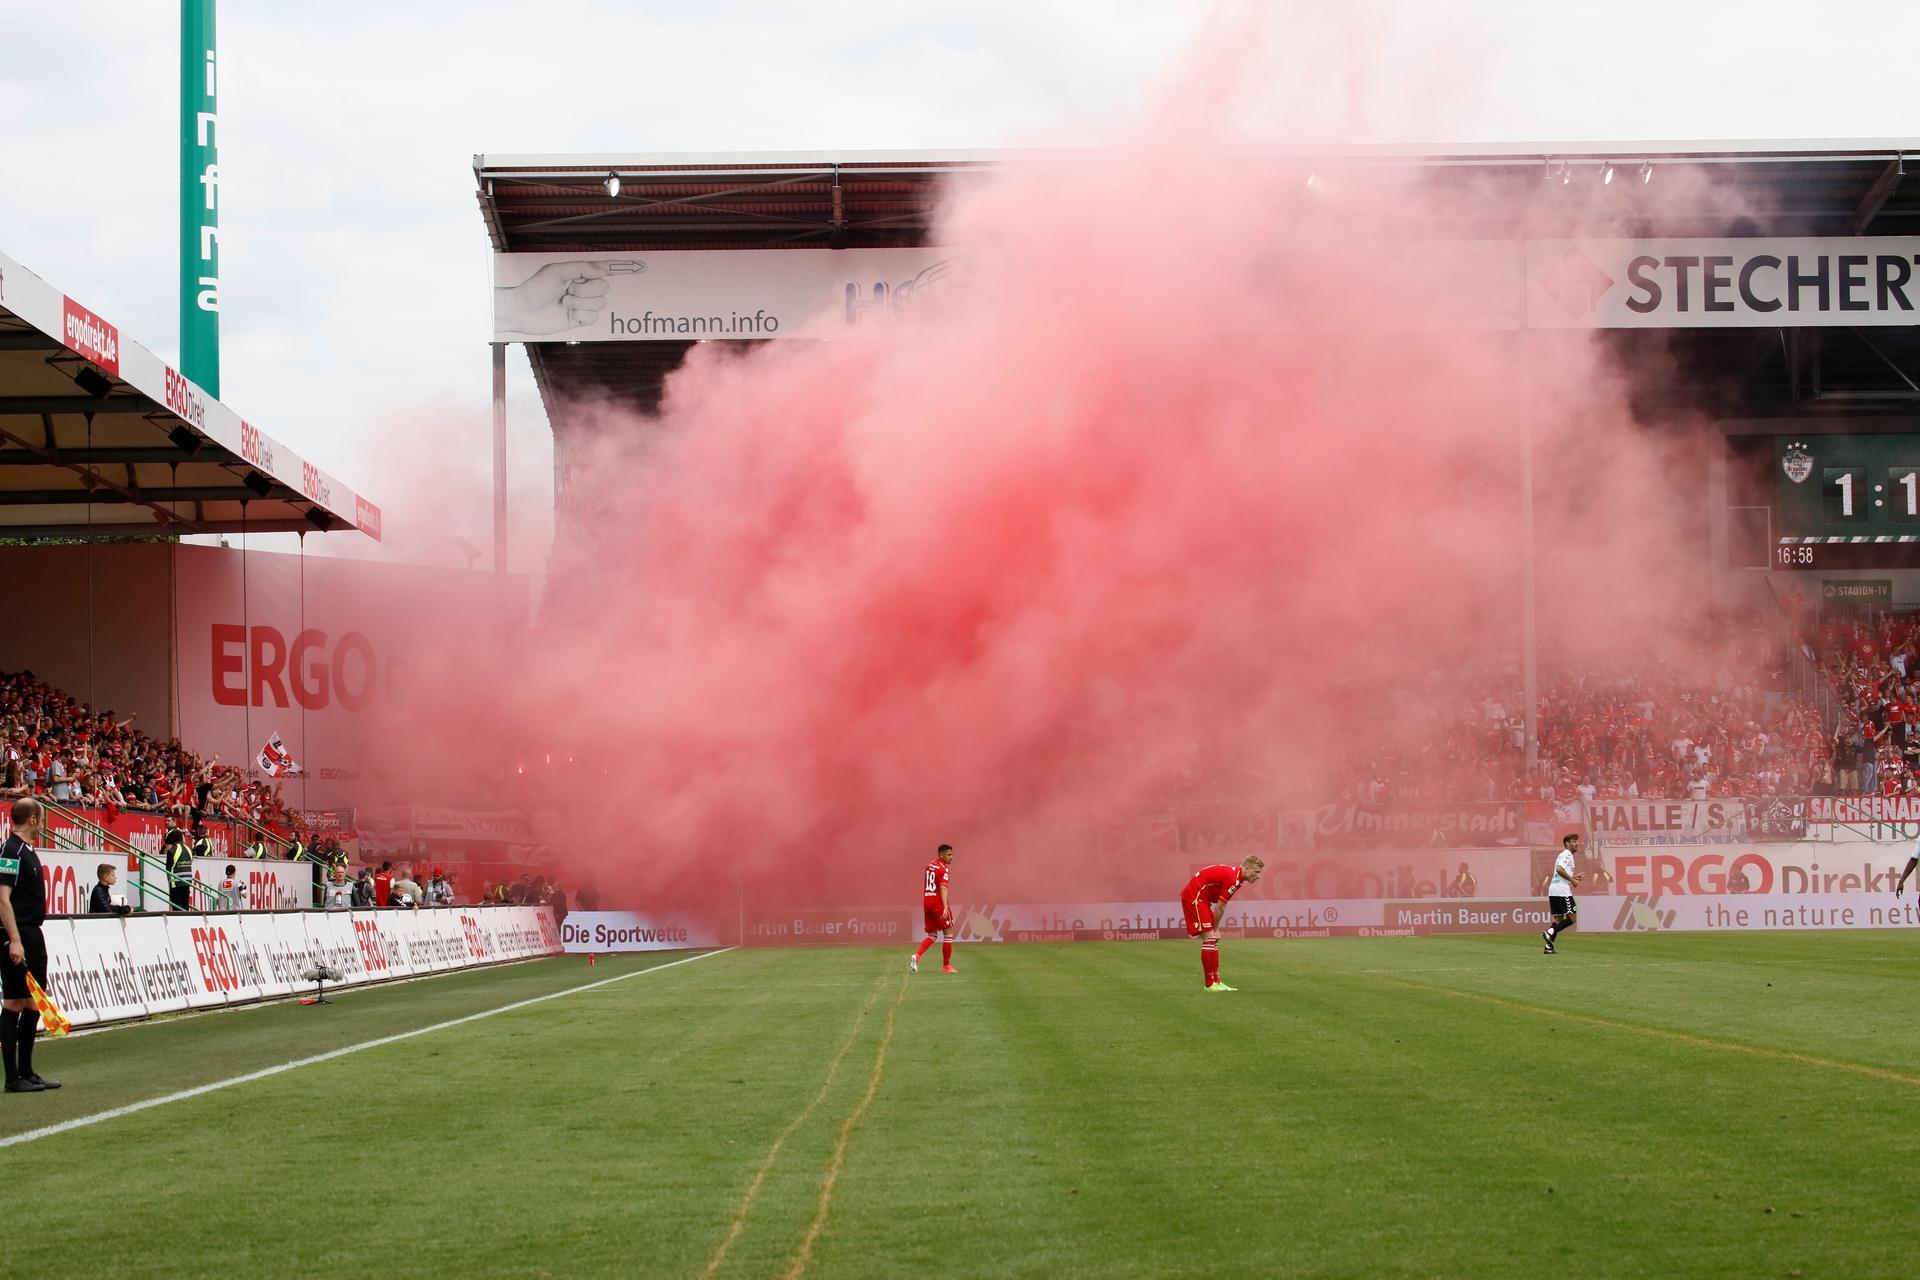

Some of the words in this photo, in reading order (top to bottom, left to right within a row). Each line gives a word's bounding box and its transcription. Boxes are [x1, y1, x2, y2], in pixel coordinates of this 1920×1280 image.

[611, 310, 779, 334] hofmann.info
[67, 312, 116, 363] ergodirekt.de
[165, 366, 188, 418] ERGO
[188, 391, 206, 429] Direkt
[241, 421, 260, 465] ERGO
[303, 461, 318, 500] ERGO
[1835, 473, 1852, 516] 1
[1899, 472, 1917, 516] 1
[1777, 547, 1813, 564] 16:58
[1838, 586, 1887, 596] STADION-TV
[211, 623, 376, 712] ERGO
[1590, 805, 1682, 831] HALLE
[926, 870, 937, 891] 18
[1614, 853, 1774, 895] ERGO
[1782, 863, 1901, 894] Direkt
[250, 871, 277, 909] ERGO
[1041, 912, 1085, 930] the
[1398, 910, 1452, 925] Martin
[1458, 909, 1507, 924] Bauer
[1512, 908, 1551, 923] Grou
[1705, 903, 1748, 927] the
[1764, 905, 1854, 926] nature
[562, 924, 590, 943] Die
[595, 924, 688, 947] Sportwette
[745, 919, 788, 936] artin
[794, 918, 843, 935] Bauer
[848, 918, 897, 937] Group
[1116, 930, 1160, 940] hummel
[1286, 928, 1330, 938] hummel
[1371, 927, 1415, 937] hummel
[191, 926, 238, 992] ERGO
[231, 939, 266, 987] Direkt
[354, 920, 386, 971] ERGO
